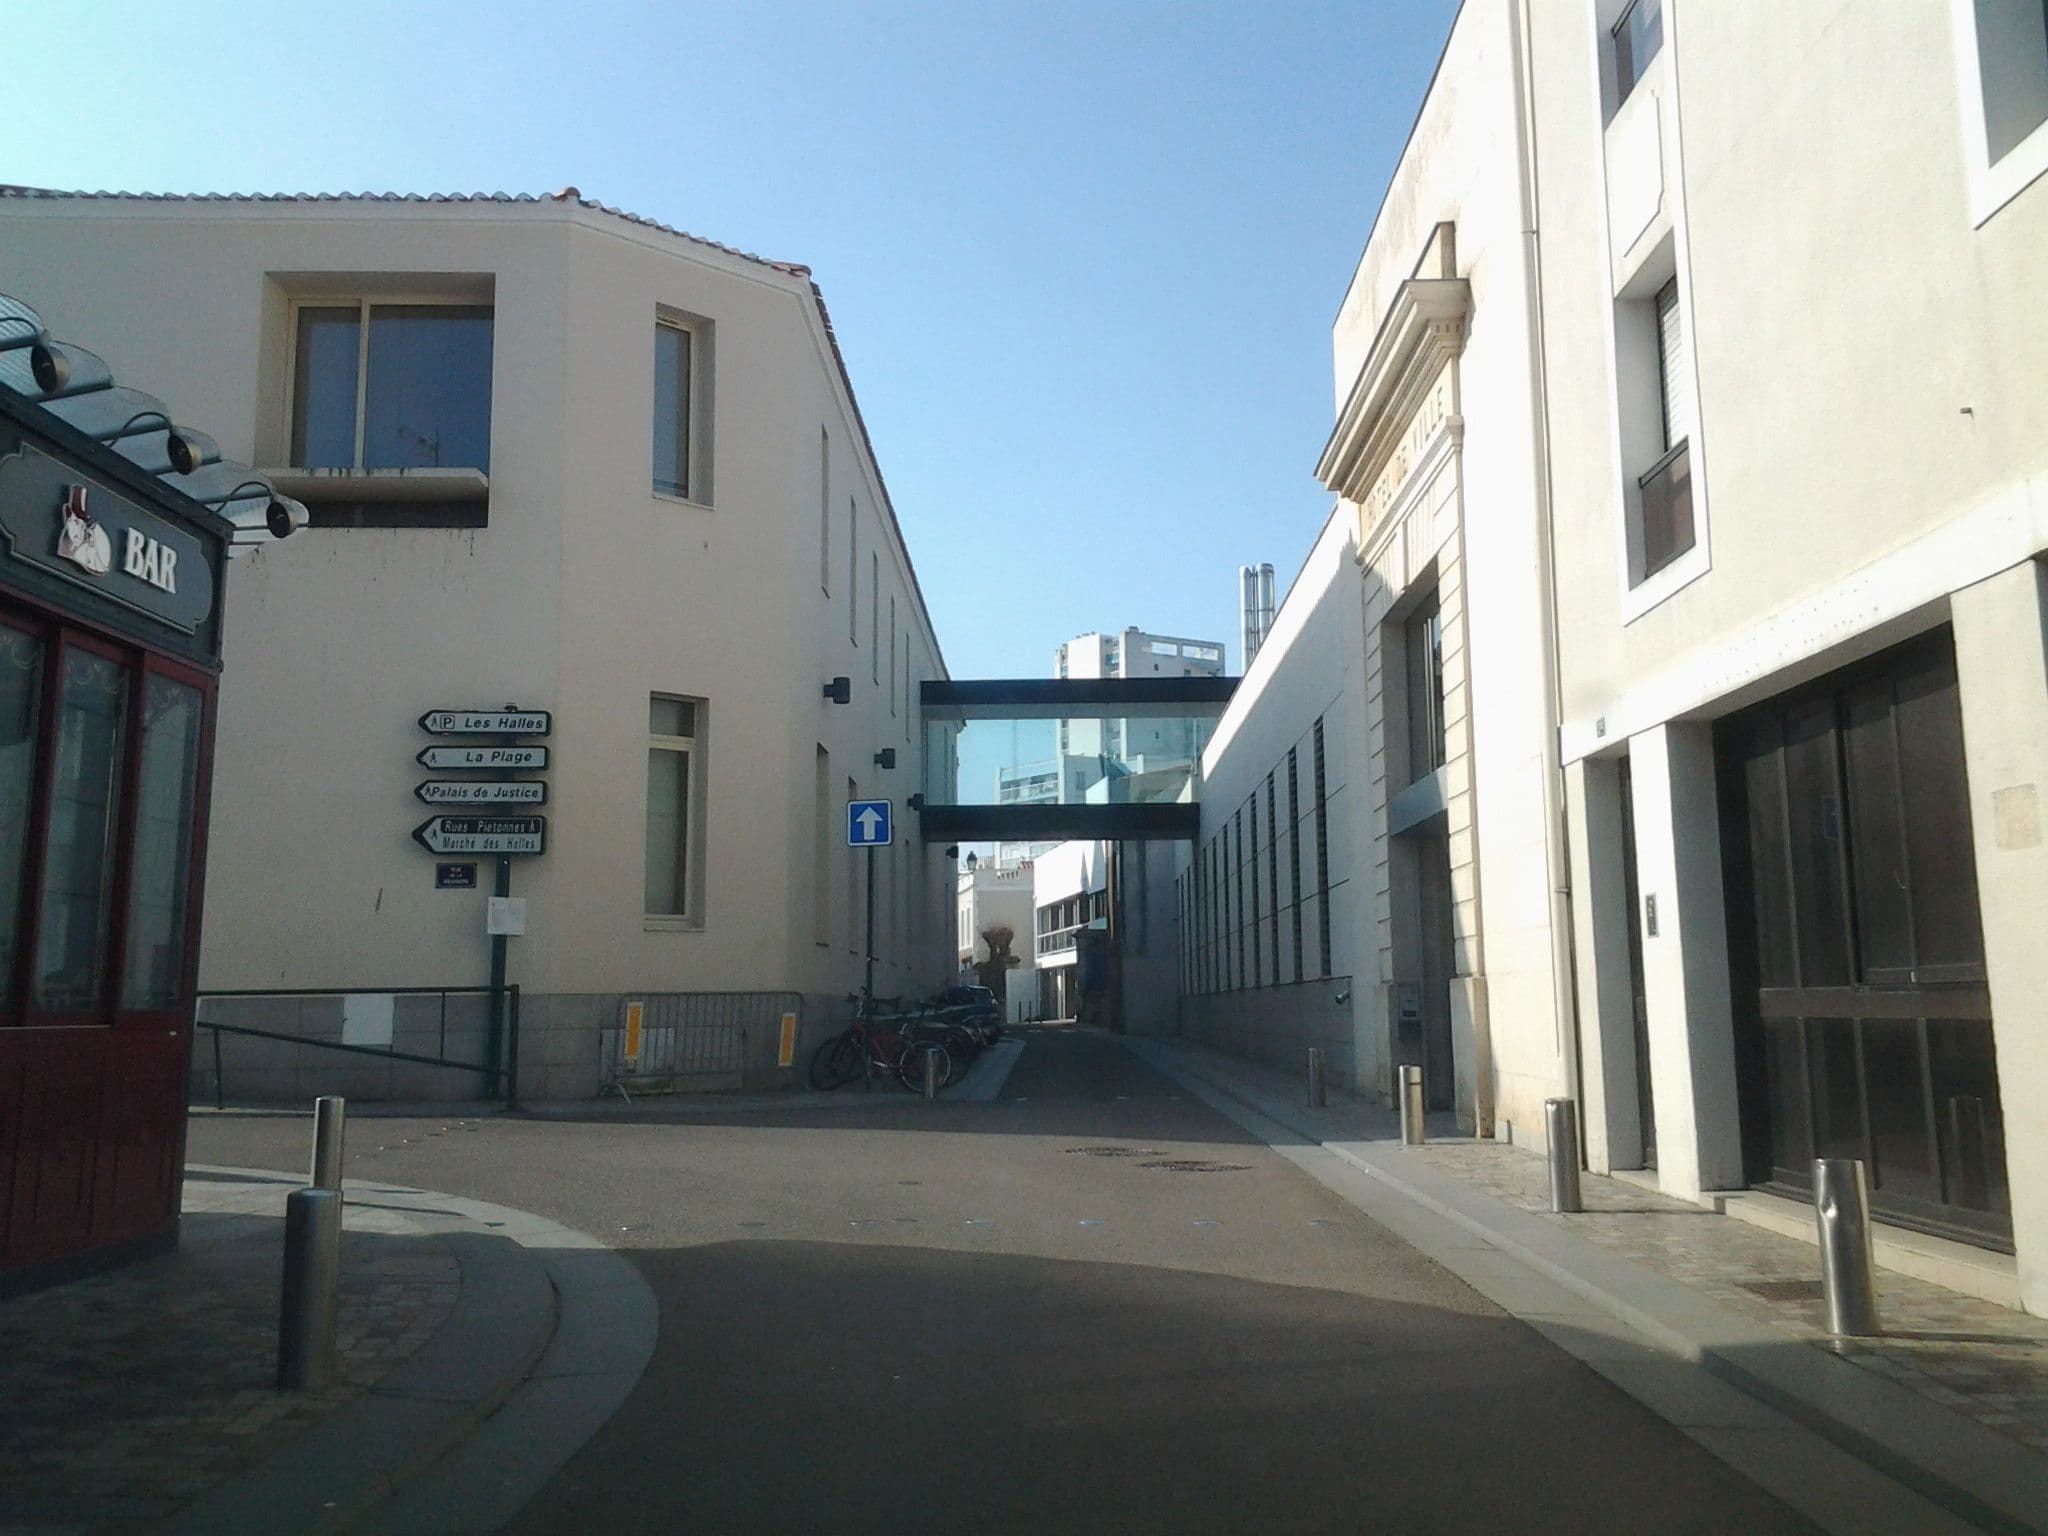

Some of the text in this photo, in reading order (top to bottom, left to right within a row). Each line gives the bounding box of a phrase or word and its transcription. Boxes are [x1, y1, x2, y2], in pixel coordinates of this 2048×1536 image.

[1413, 385, 1444, 453] VILLE
[124, 526, 177, 594] BAR
[465, 717, 491, 729] Les
[498, 717, 543, 729] Halles
[466, 751, 532, 764] La Plage
[432, 786, 539, 798] Palais de Justice
[445, 820, 468, 832] Rues
[483, 837, 499, 849] des
[507, 837, 535, 849] Halles
